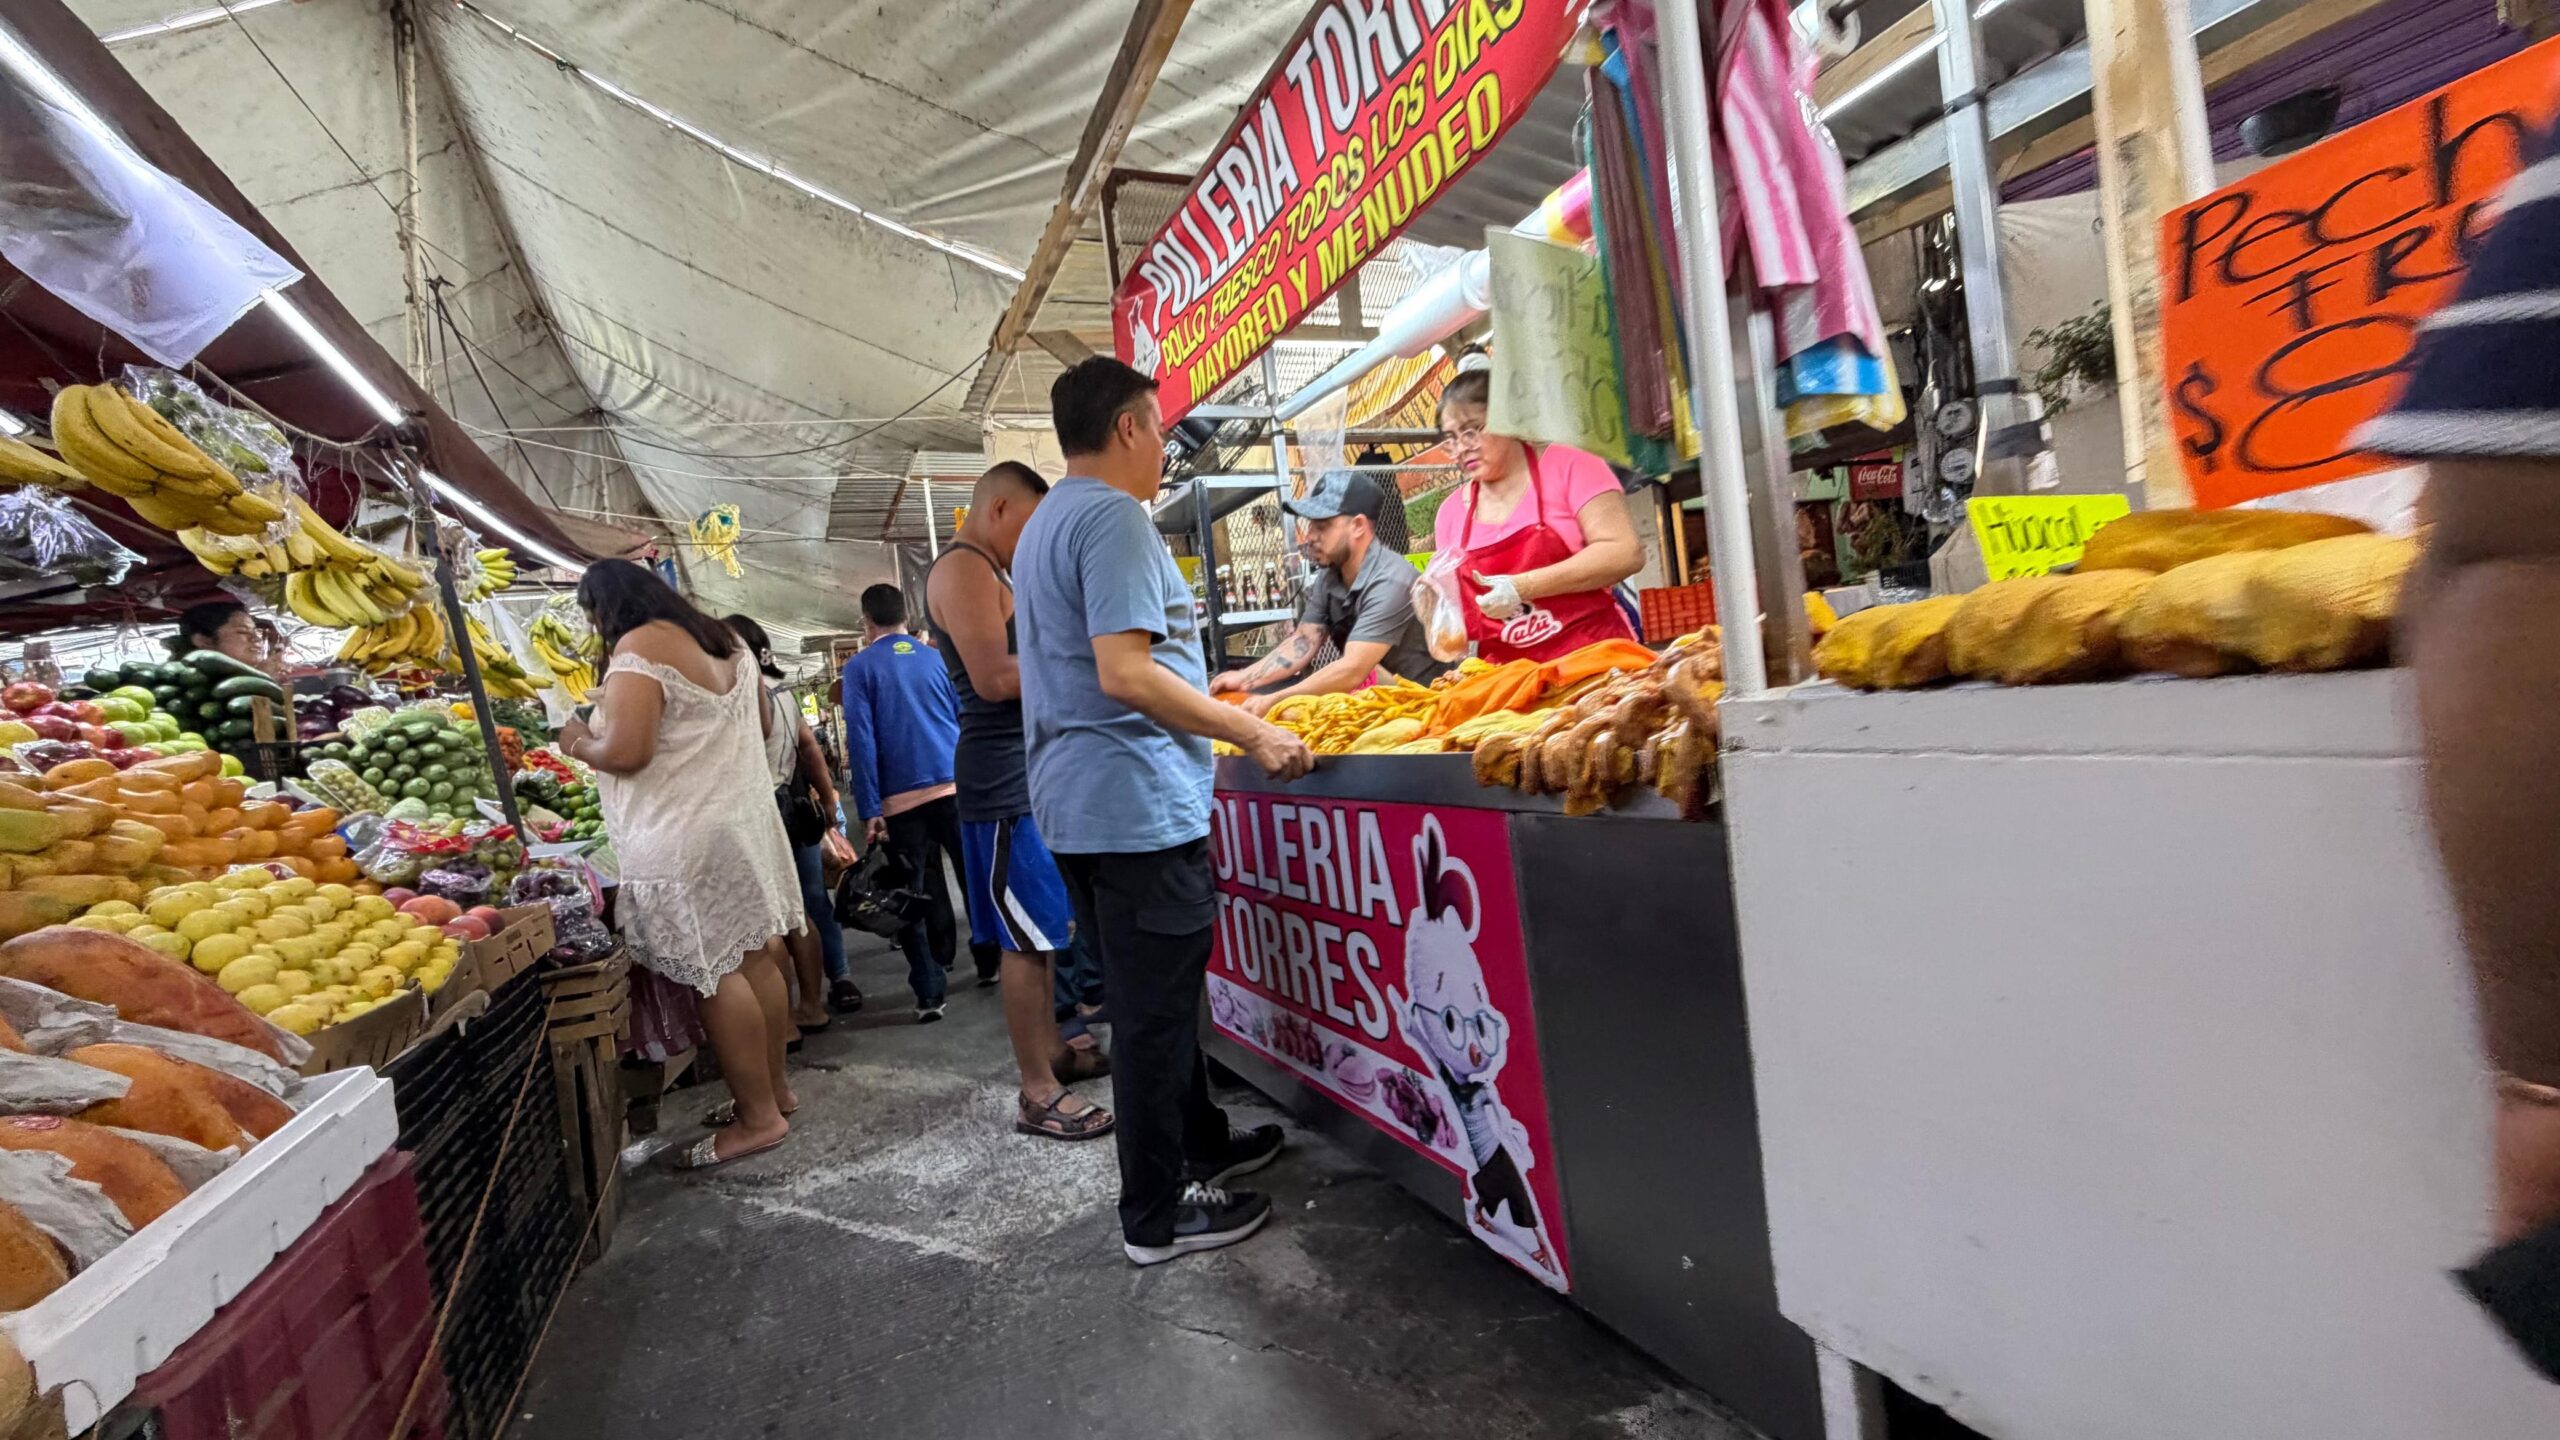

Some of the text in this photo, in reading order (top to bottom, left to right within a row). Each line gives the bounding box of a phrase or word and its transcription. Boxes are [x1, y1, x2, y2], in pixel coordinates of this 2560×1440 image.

[1139, 97, 1300, 335] POLLERIA
[1161, 303, 1207, 377] POLLO
[1209, 229, 1282, 331] FRESCO
[1286, 134, 1366, 254] TODOS
[1370, 61, 1427, 169] LOS
[1188, 72, 1501, 404] MAYOREO Y MENUDEO
[1211, 796, 1403, 926] OLLERIA
[1215, 890, 1390, 1040] TORRES
